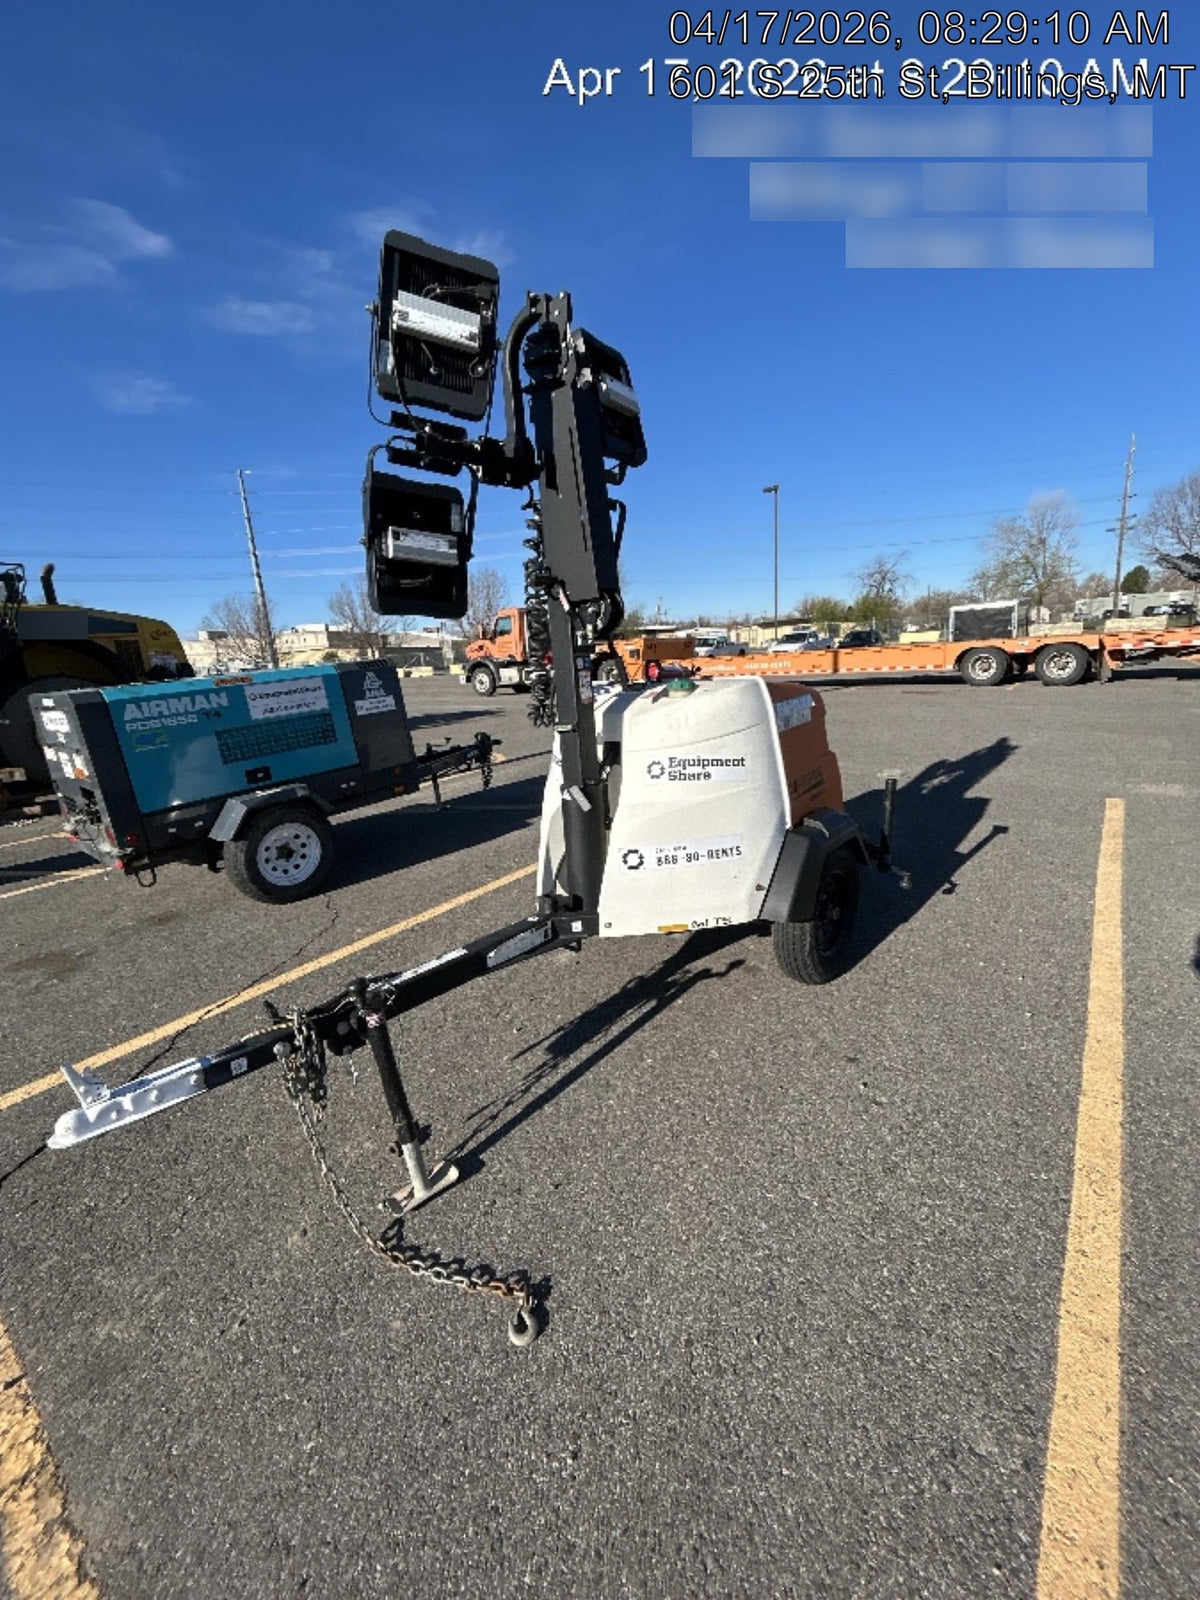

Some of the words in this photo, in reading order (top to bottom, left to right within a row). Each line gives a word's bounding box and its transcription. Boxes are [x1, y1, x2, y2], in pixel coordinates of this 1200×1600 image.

[124, 692, 229, 720] AIRMAN
[668, 755, 746, 770] Equipment
[668, 769, 712, 781] Share
